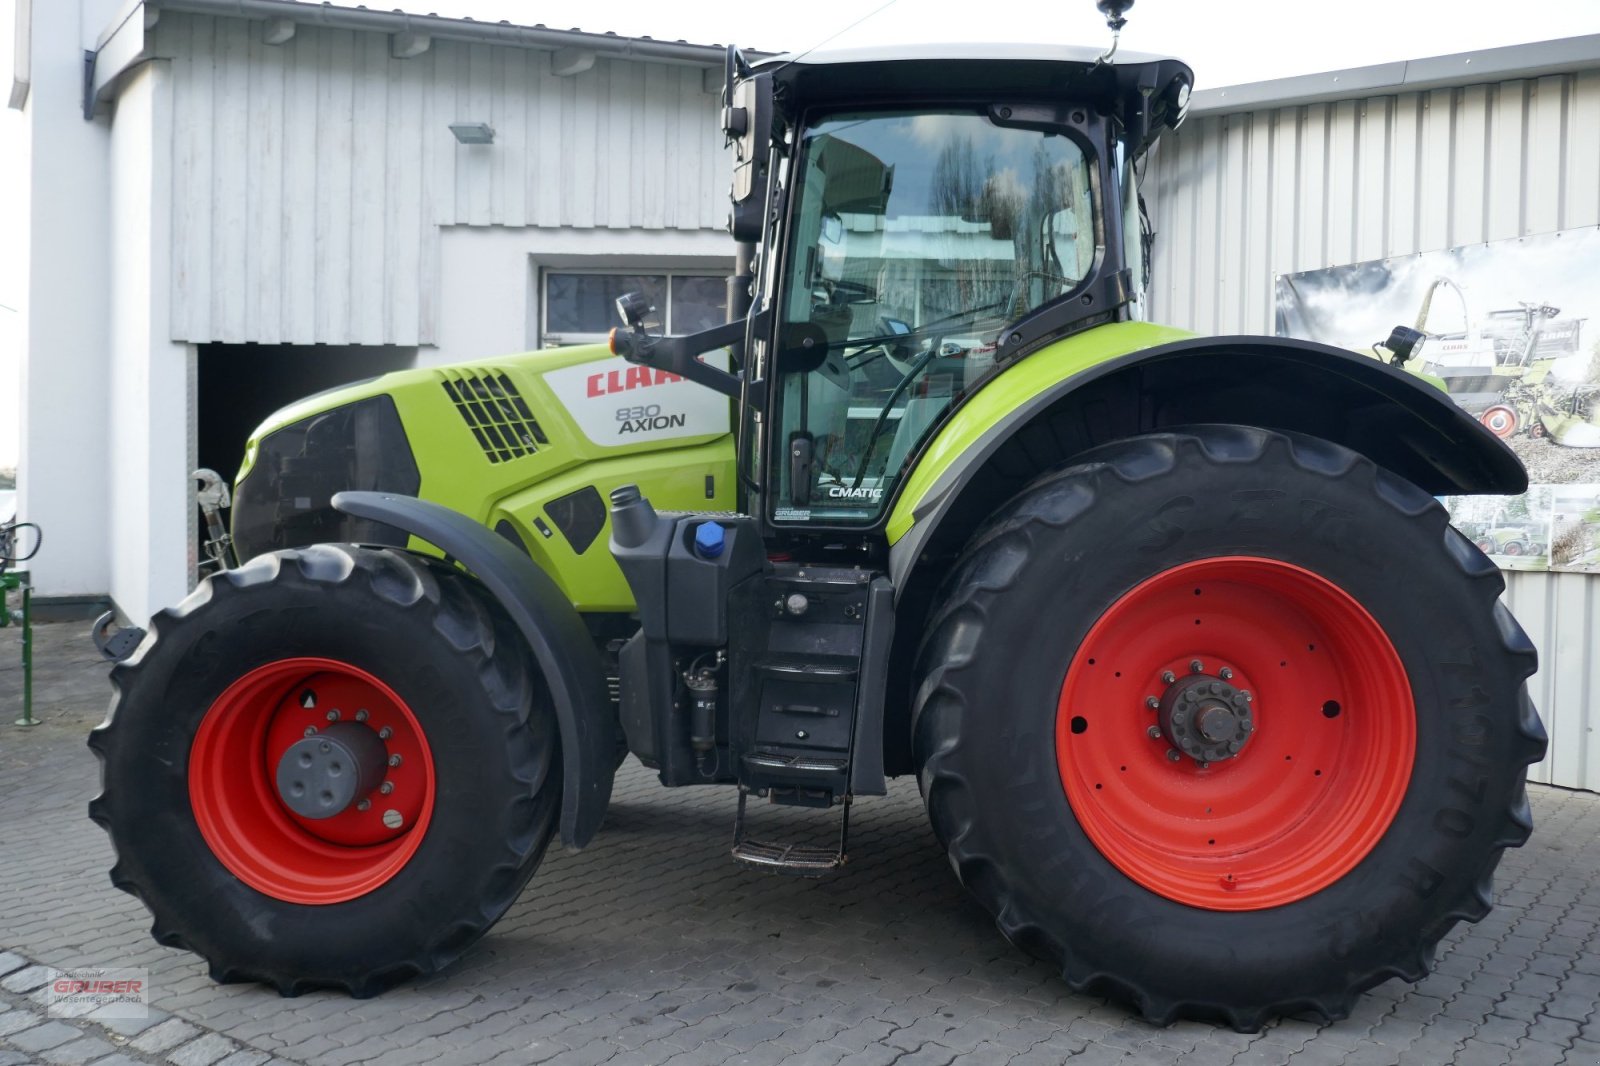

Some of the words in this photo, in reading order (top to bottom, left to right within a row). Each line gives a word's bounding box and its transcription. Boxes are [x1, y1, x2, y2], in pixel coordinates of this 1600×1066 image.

[1442, 343, 1469, 351] CLAAS
[615, 404, 661, 421] 830
[618, 414, 686, 435] AXION
[829, 487, 884, 498] CMATIC
